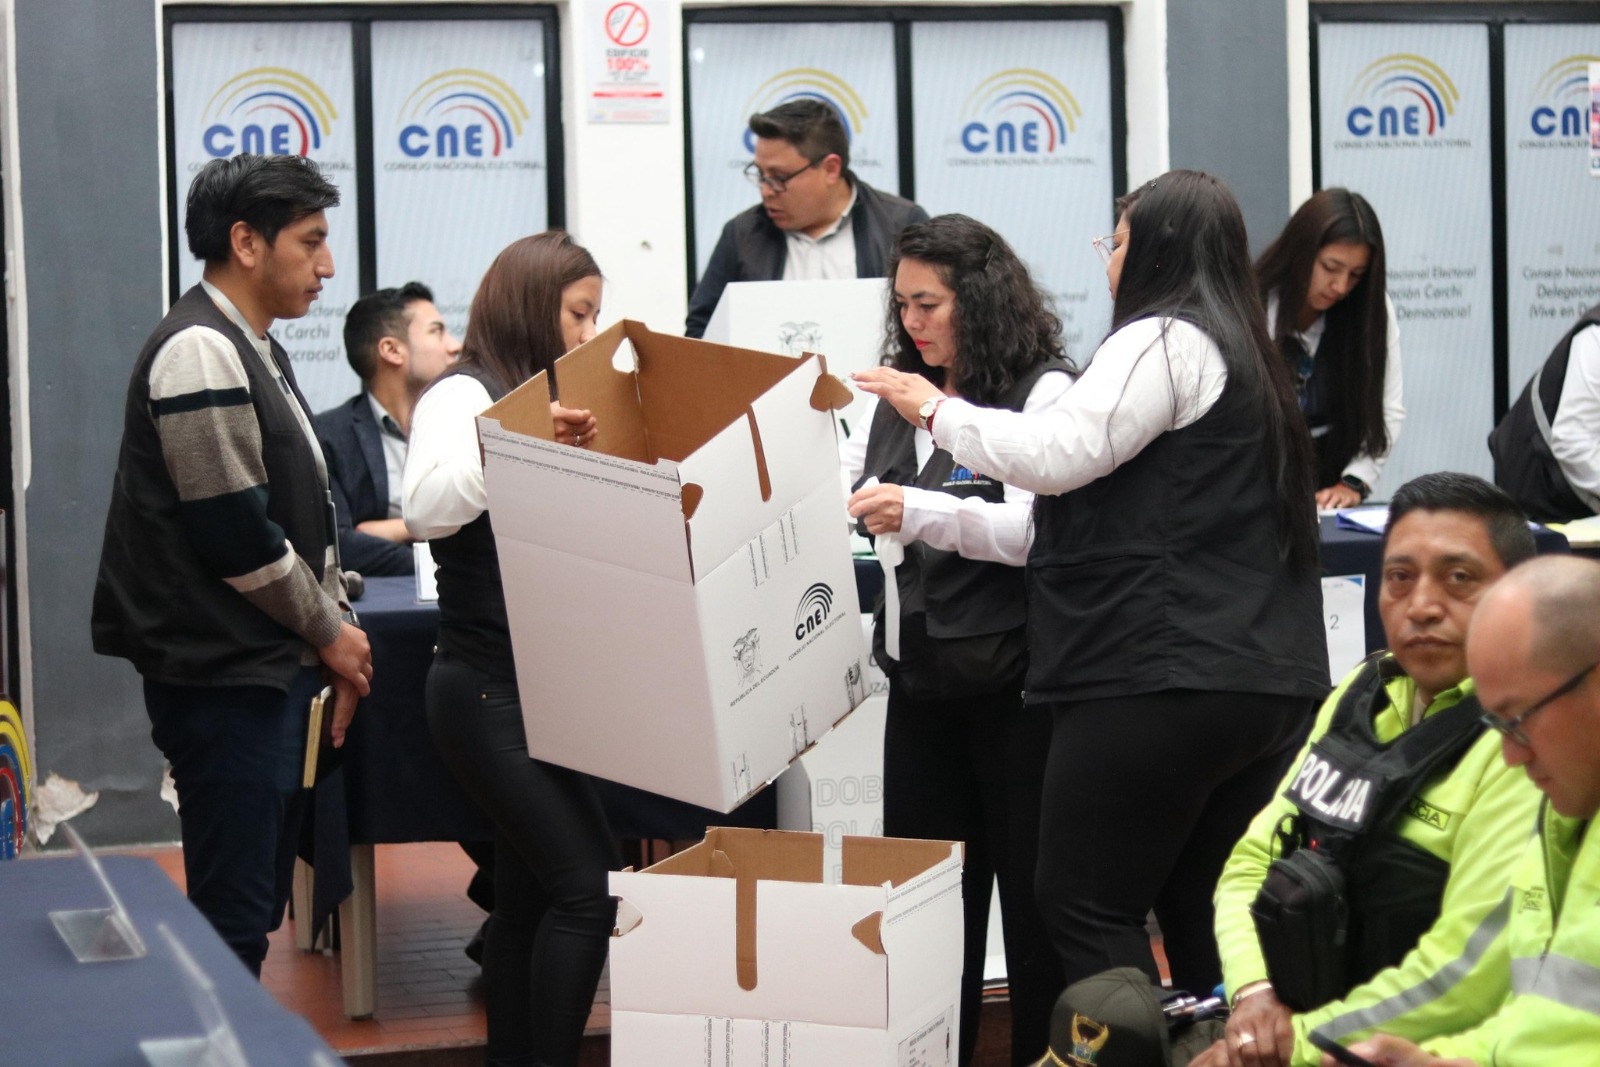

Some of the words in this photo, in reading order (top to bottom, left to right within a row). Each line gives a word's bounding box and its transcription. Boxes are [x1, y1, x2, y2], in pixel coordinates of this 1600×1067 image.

[961, 121, 1039, 154] CNE
[1346, 105, 1419, 137] CNE
[1530, 105, 1590, 137] CN
[203, 123, 290, 157] CNE
[398, 123, 483, 158] CNE
[1565, 265, 1600, 279] Nacion
[284, 322, 331, 341] Carchi
[795, 608, 822, 641] CNE
[815, 774, 884, 808] DOB
